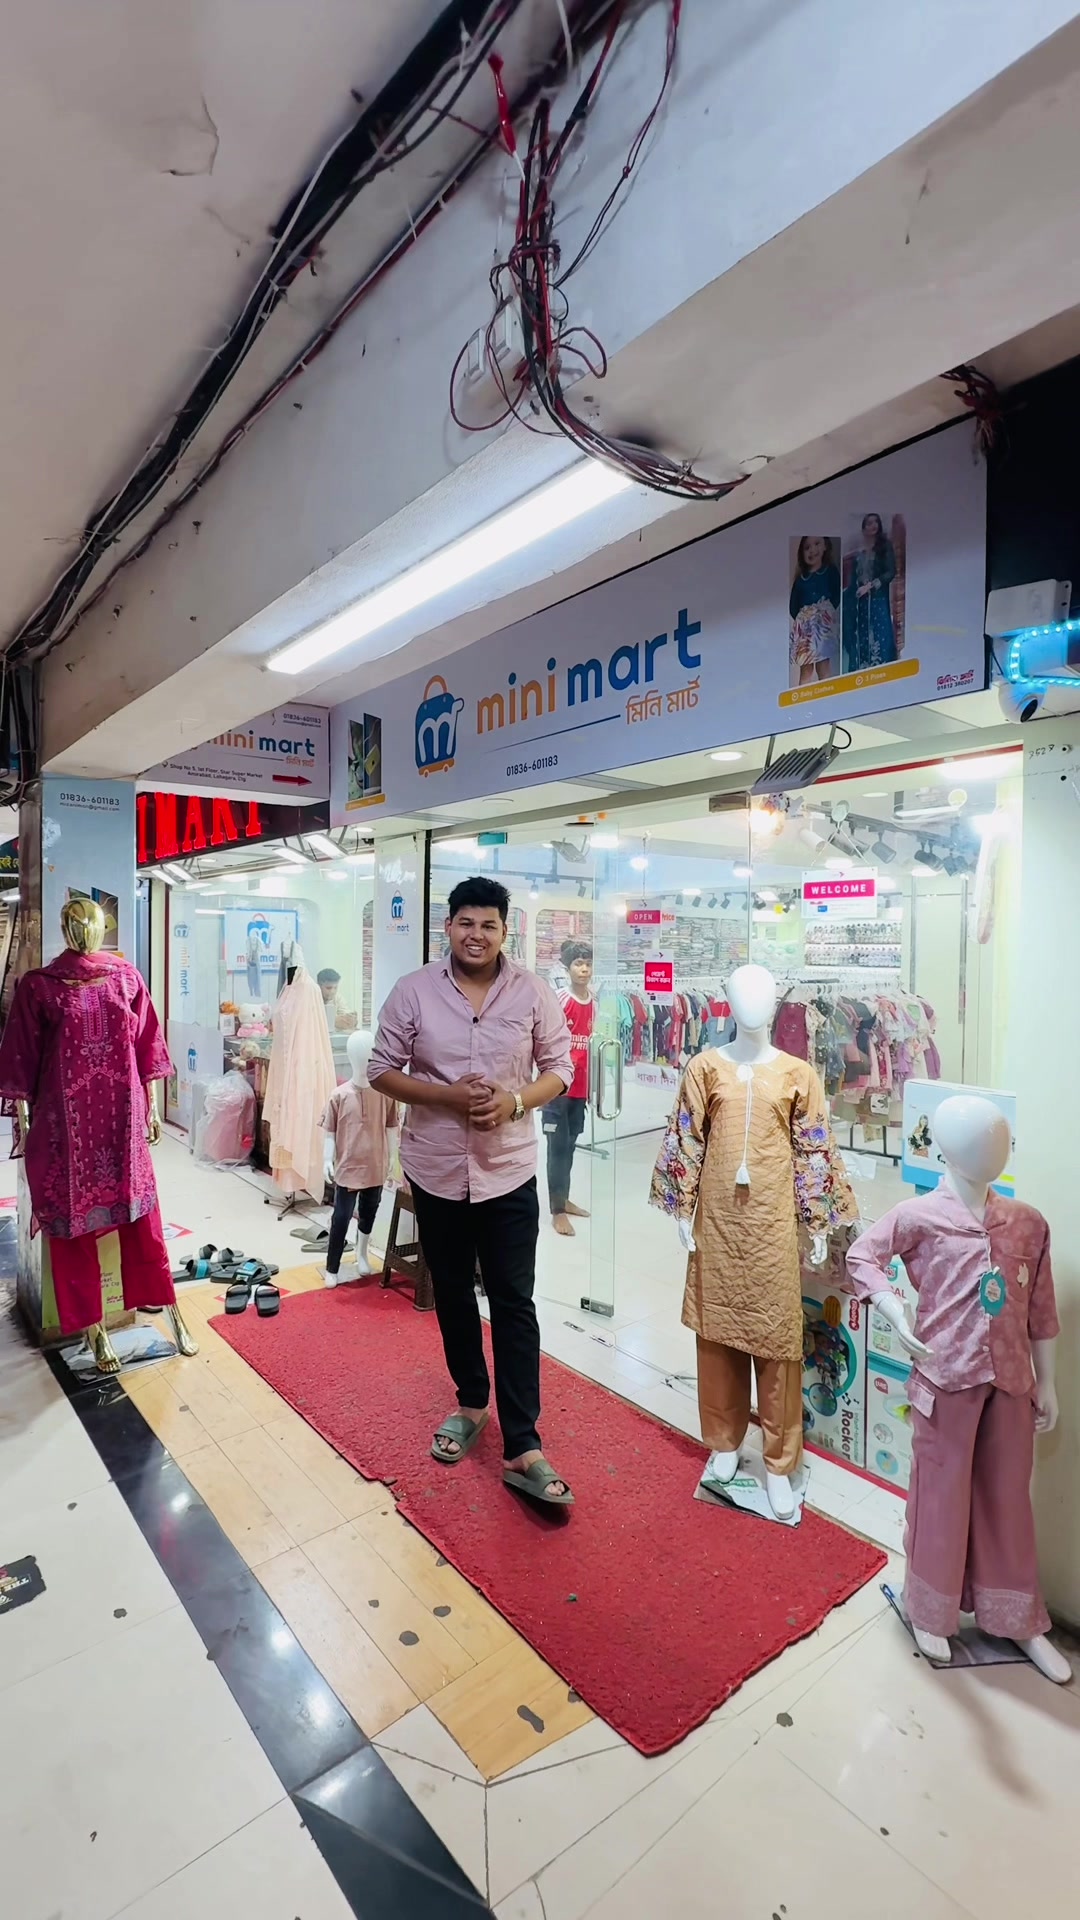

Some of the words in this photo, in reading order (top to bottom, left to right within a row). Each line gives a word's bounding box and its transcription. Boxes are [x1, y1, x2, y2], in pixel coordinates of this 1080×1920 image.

[476, 657, 556, 735] mini
[567, 608, 701, 707] mart
[625, 689, 662, 725] মিনি
[666, 675, 701, 714] মার্ট
[259, 737, 315, 756] mart
[506, 755, 558, 777] 01836-601183
[60, 793, 120, 806] 01836-601183
[811, 884, 867, 895] WELCOME
[634, 913, 653, 921] OPEN
[180, 970, 190, 997] mart
[571, 1033, 588, 1043] mira
[841, 1408, 854, 1460] Rocker
